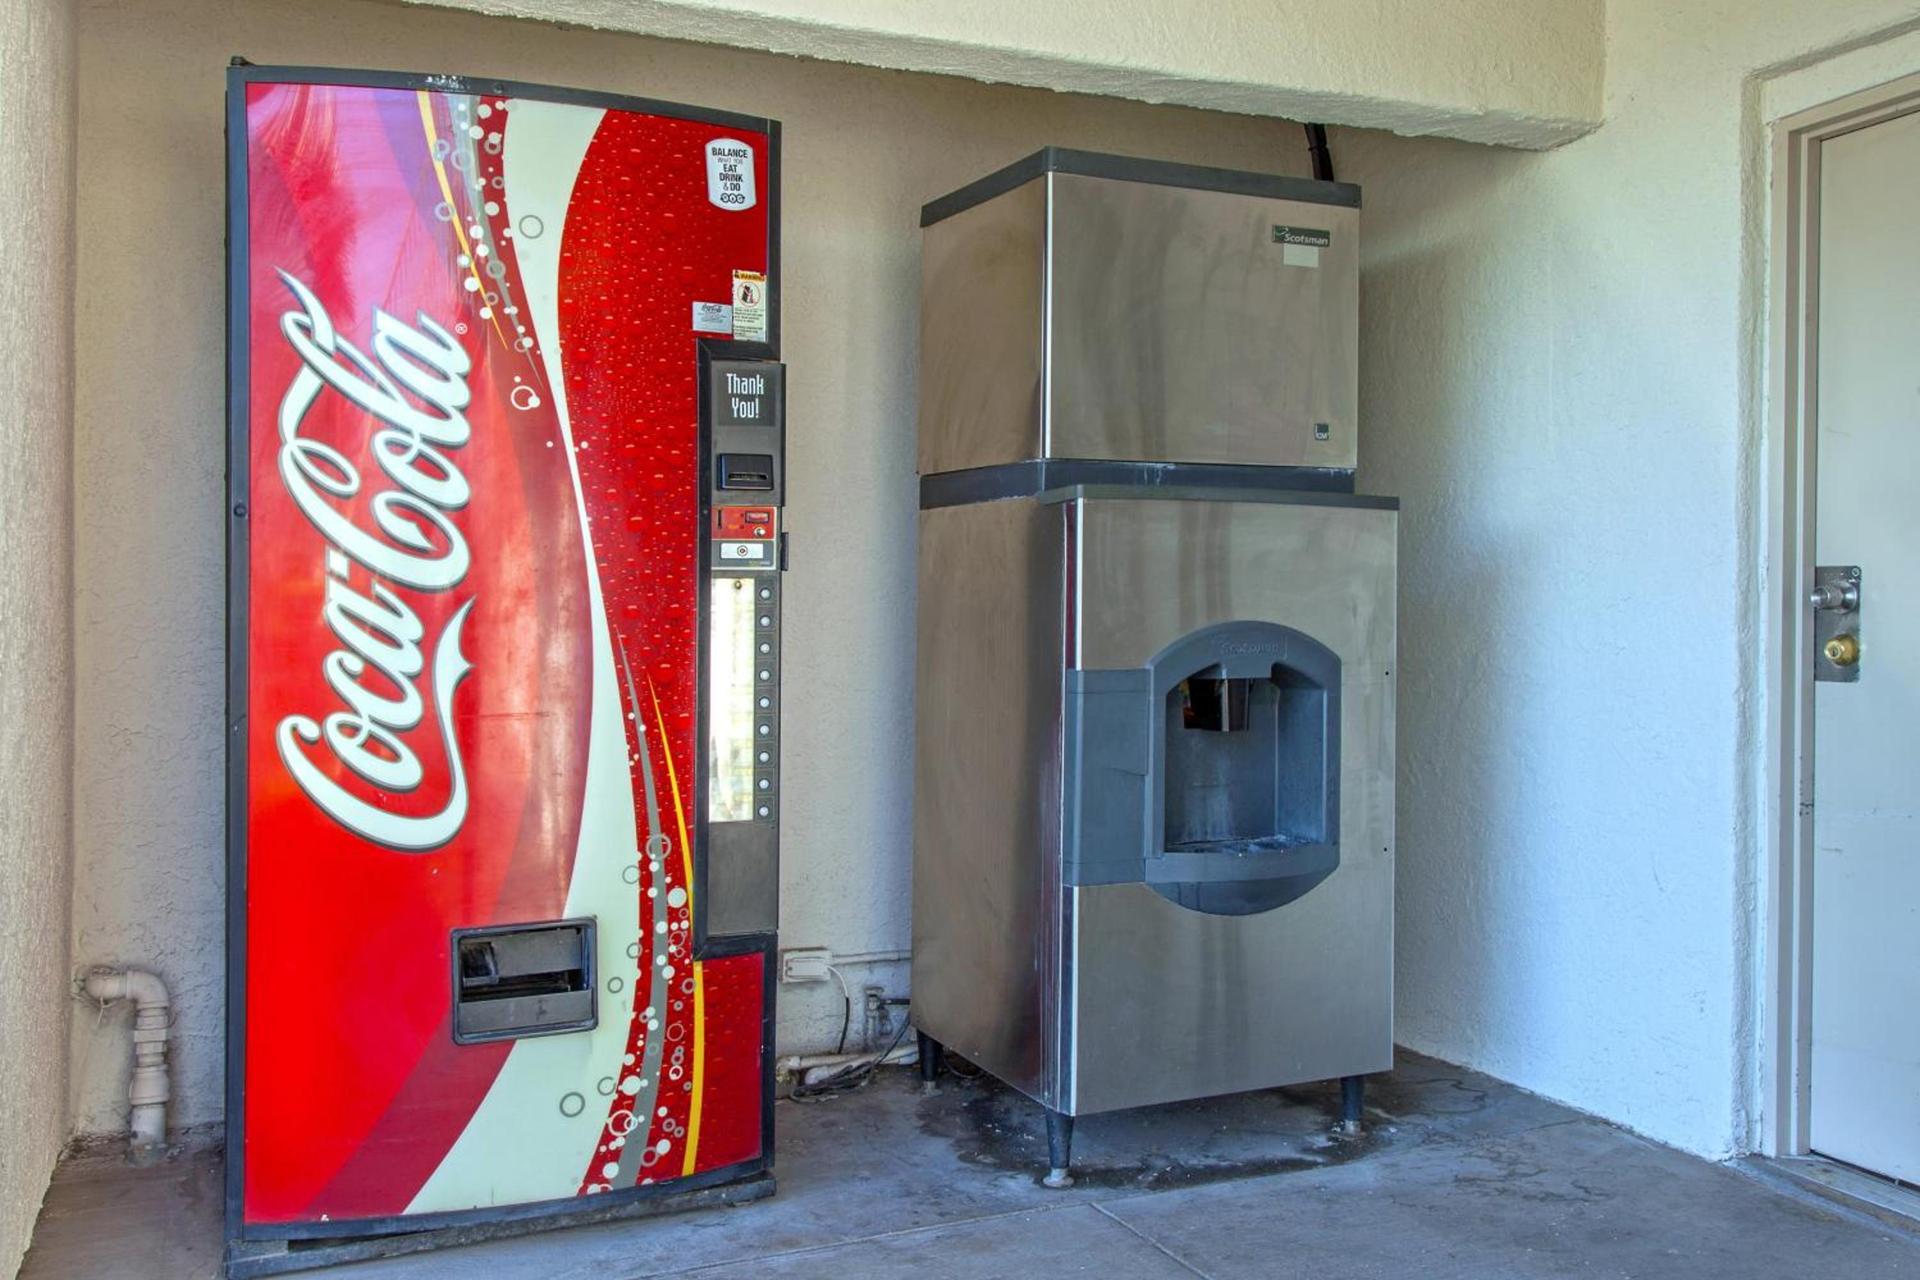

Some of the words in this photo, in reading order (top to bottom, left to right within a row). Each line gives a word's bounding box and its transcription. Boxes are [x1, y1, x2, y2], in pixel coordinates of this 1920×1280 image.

[711, 146, 748, 159] BALANCE
[723, 163, 738, 173] EAT
[719, 172, 744, 183] DRINK
[730, 182, 741, 191] DO
[1283, 233, 1329, 246] Scotsman
[726, 373, 765, 396] Thank
[731, 397, 760, 419] You!
[276, 266, 476, 852] Coca-Cola
